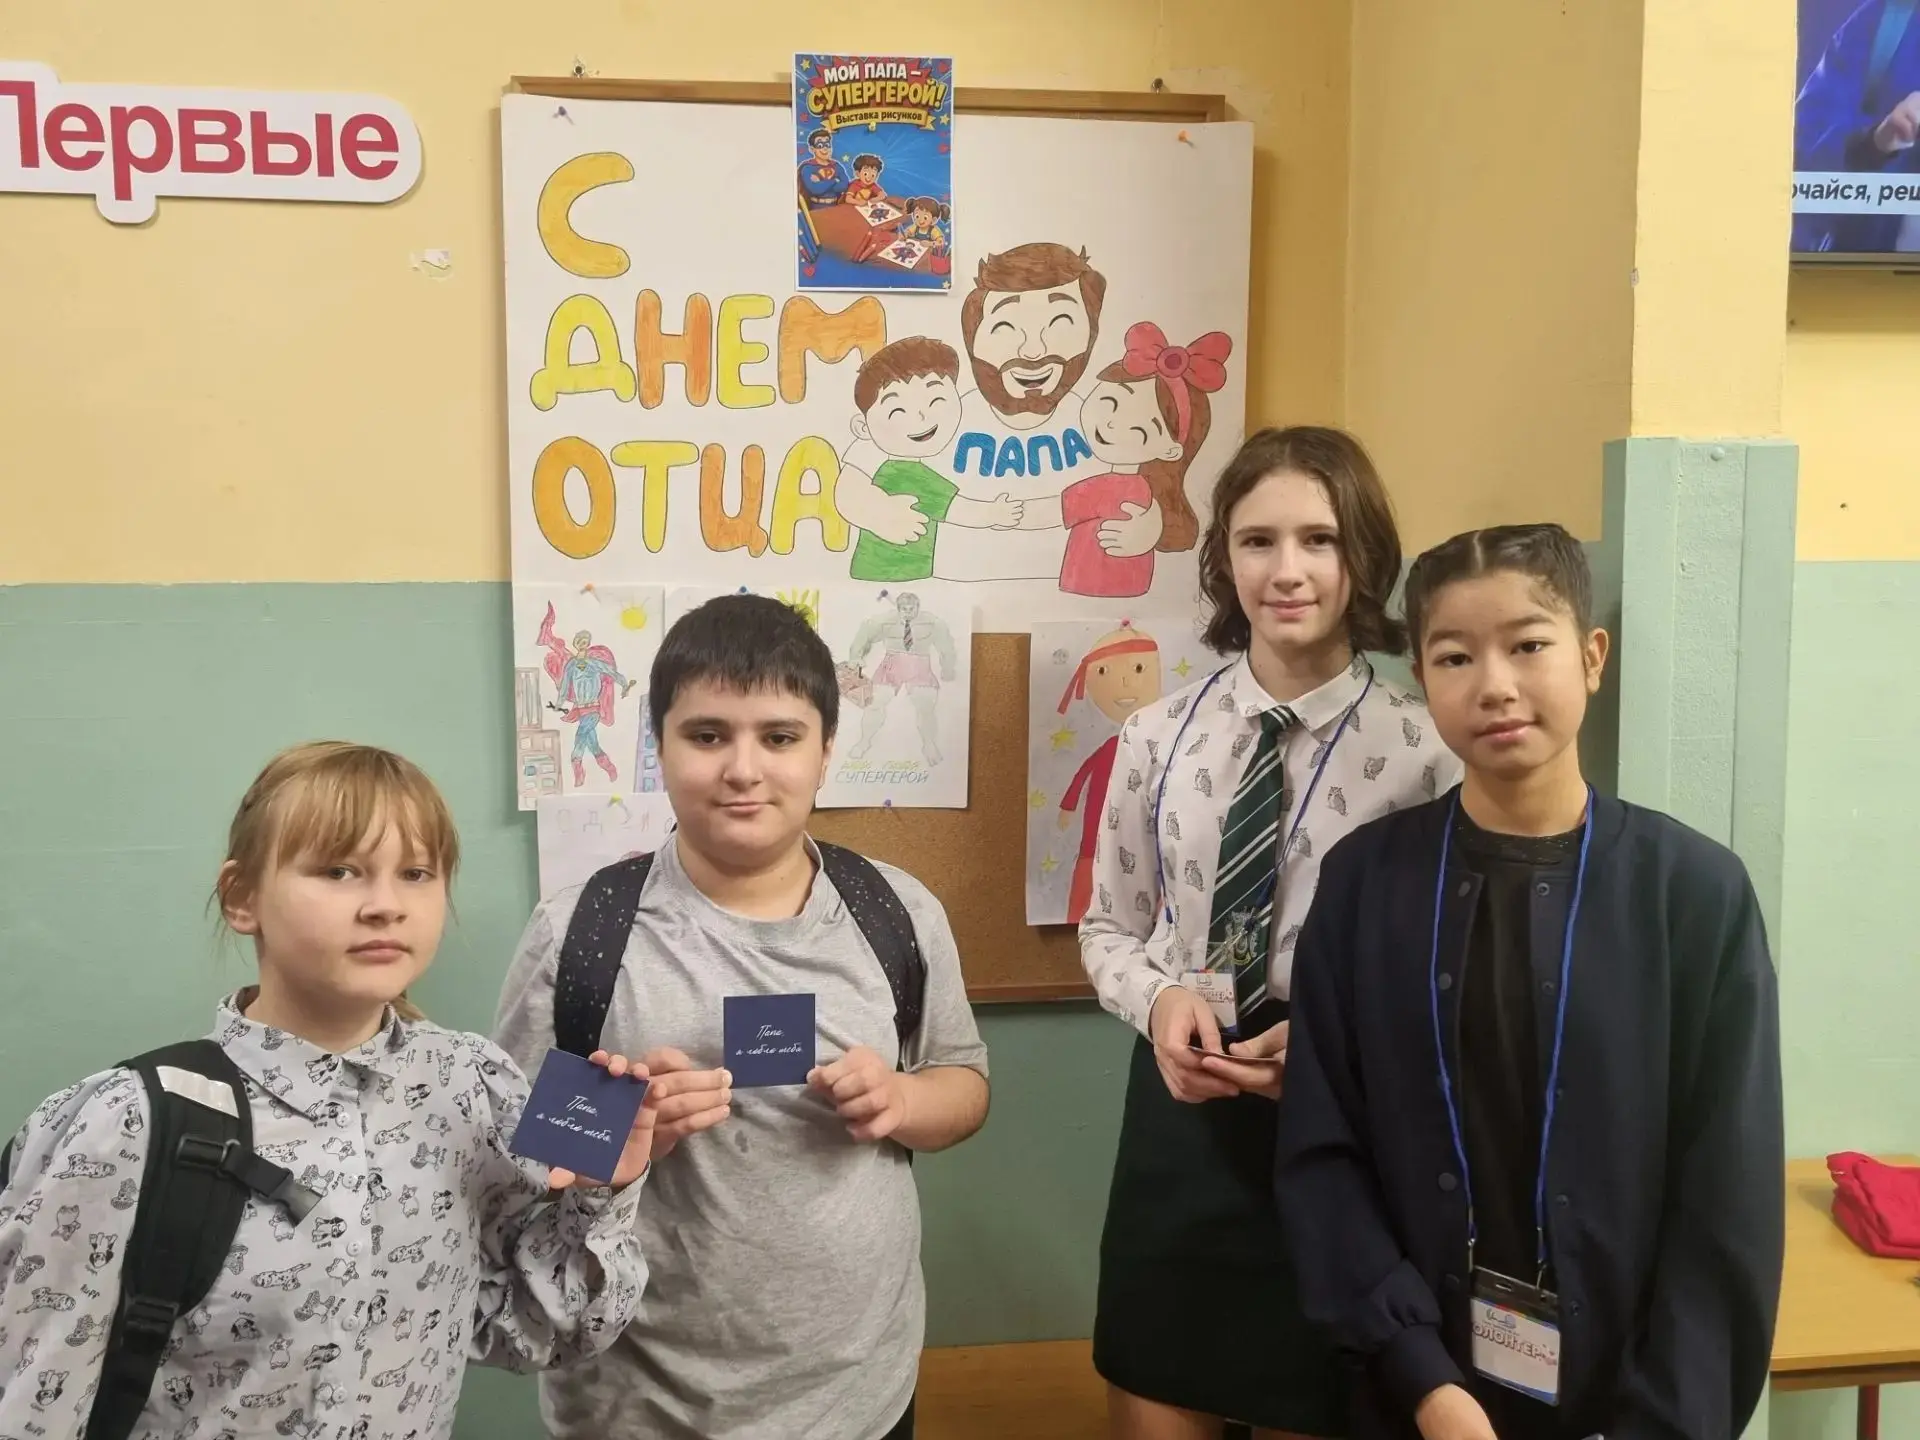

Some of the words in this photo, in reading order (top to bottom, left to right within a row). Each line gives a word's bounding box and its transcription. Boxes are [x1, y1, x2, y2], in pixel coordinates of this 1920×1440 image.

[823, 61, 860, 85] МОЙ
[864, 62, 908, 80] ПАПА
[808, 78, 946, 114] СУПЕРГЕРОЙ!
[836, 110, 879, 125] Выставка
[881, 111, 923, 121] рисунков
[537, 152, 635, 279] С
[529, 288, 887, 411] ДНЕМ
[952, 430, 1093, 478] ПАПА
[531, 435, 850, 559] ОТЦА
[835, 768, 930, 785] СУПЕРГЕРОЙ
